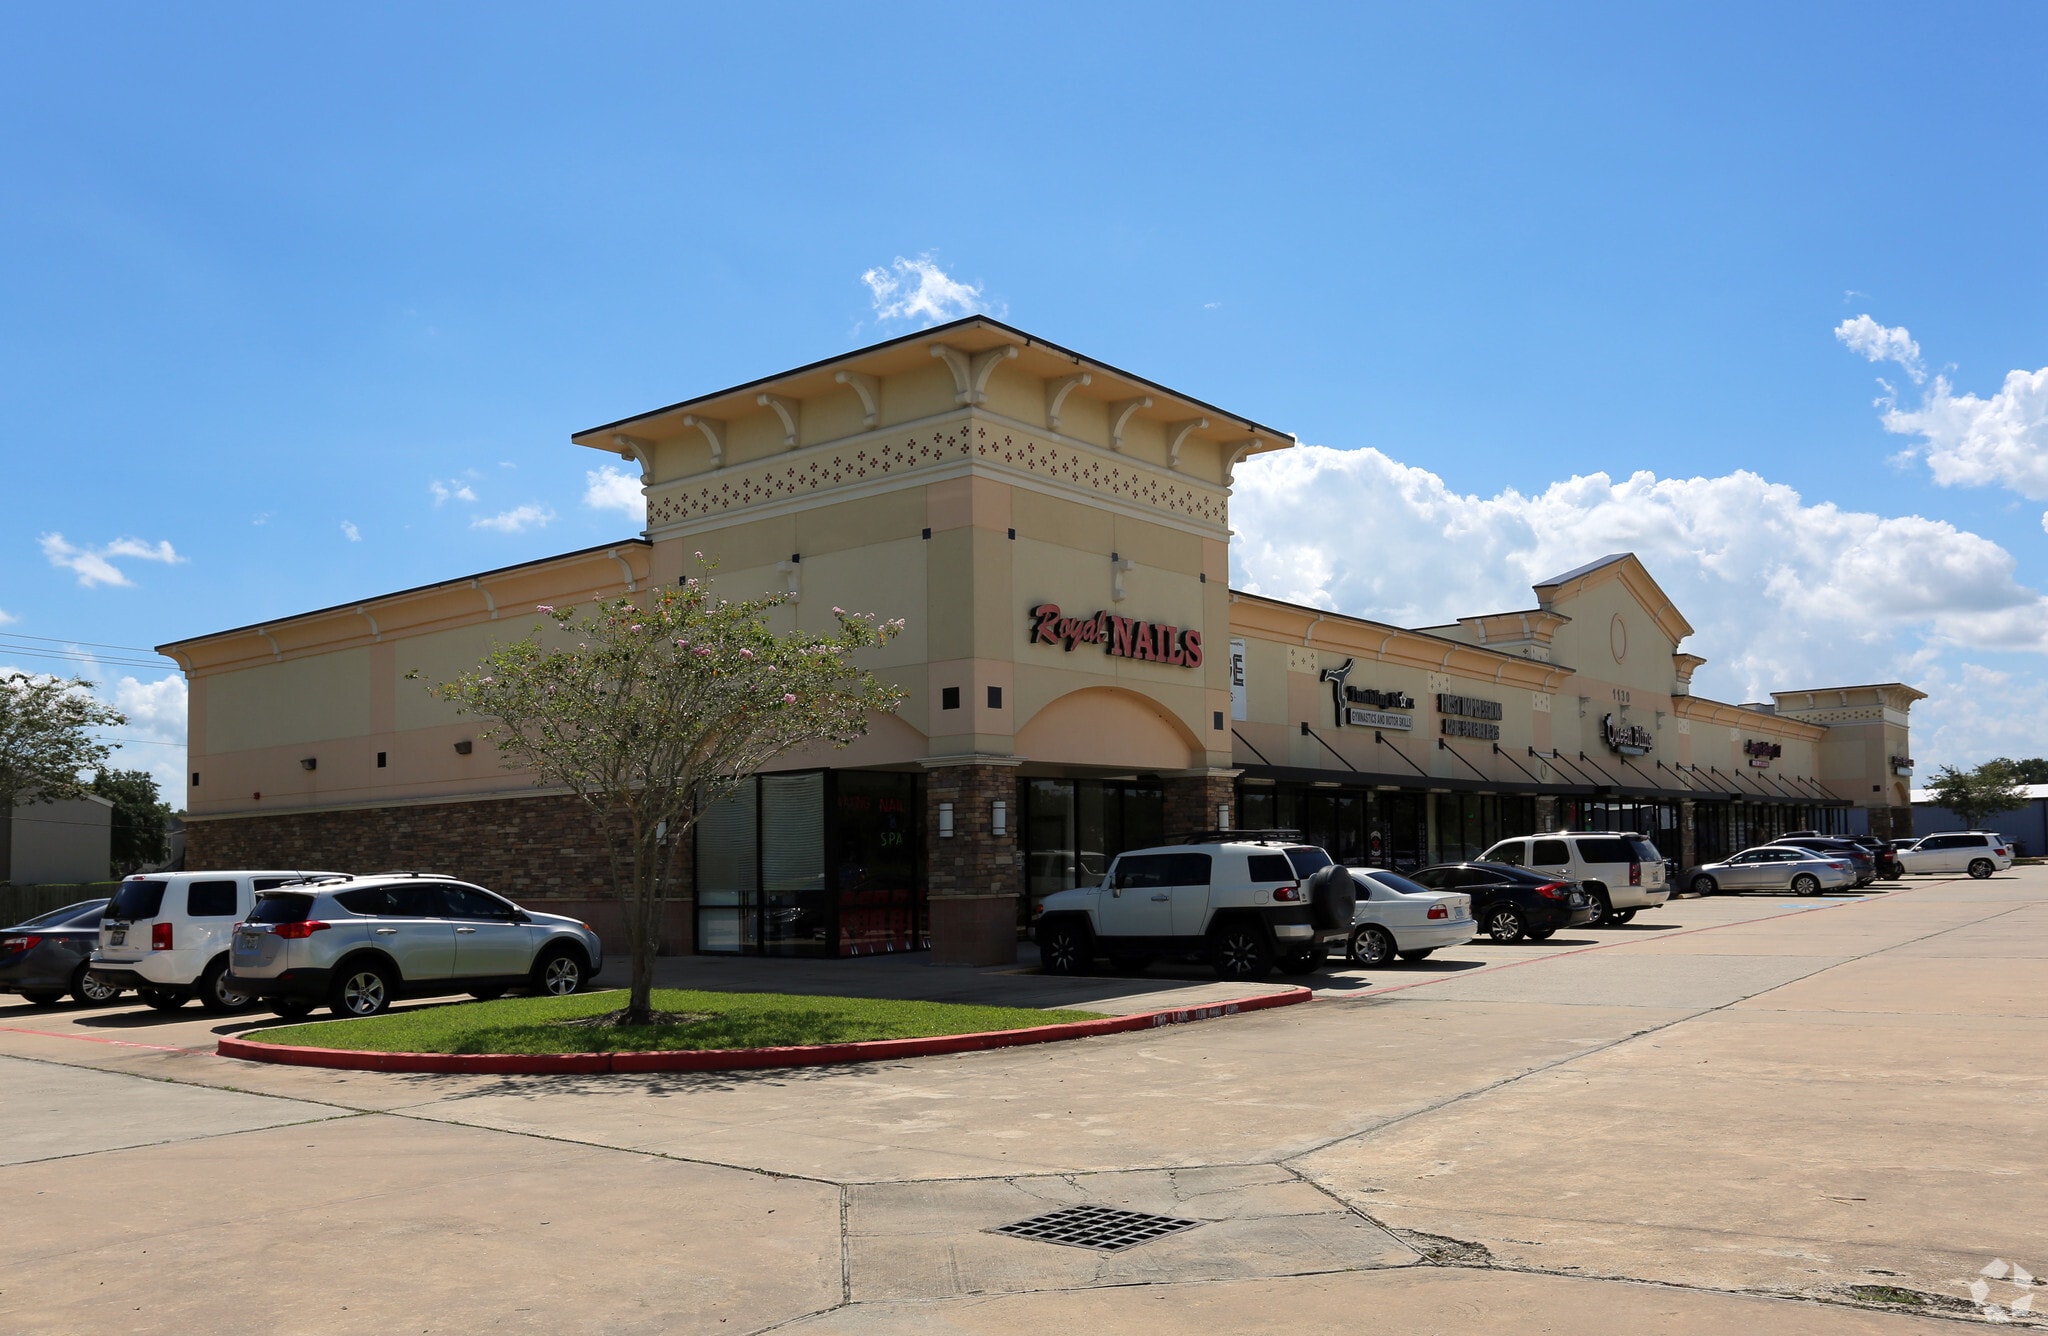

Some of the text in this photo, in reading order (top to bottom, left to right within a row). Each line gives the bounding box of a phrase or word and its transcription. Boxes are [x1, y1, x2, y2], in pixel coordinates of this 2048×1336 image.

[1030, 604, 1203, 669] Royal NAILS
[1612, 688, 1631, 703] 1130
[1351, 710, 1412, 728] GYMNASTICS AND MOTOR SKILLS
[1607, 724, 1633, 747] Queen
[880, 831, 903, 847] SPA
[1153, 1013, 1168, 1027] FIRE
[1172, 1010, 1189, 1024] LANE
